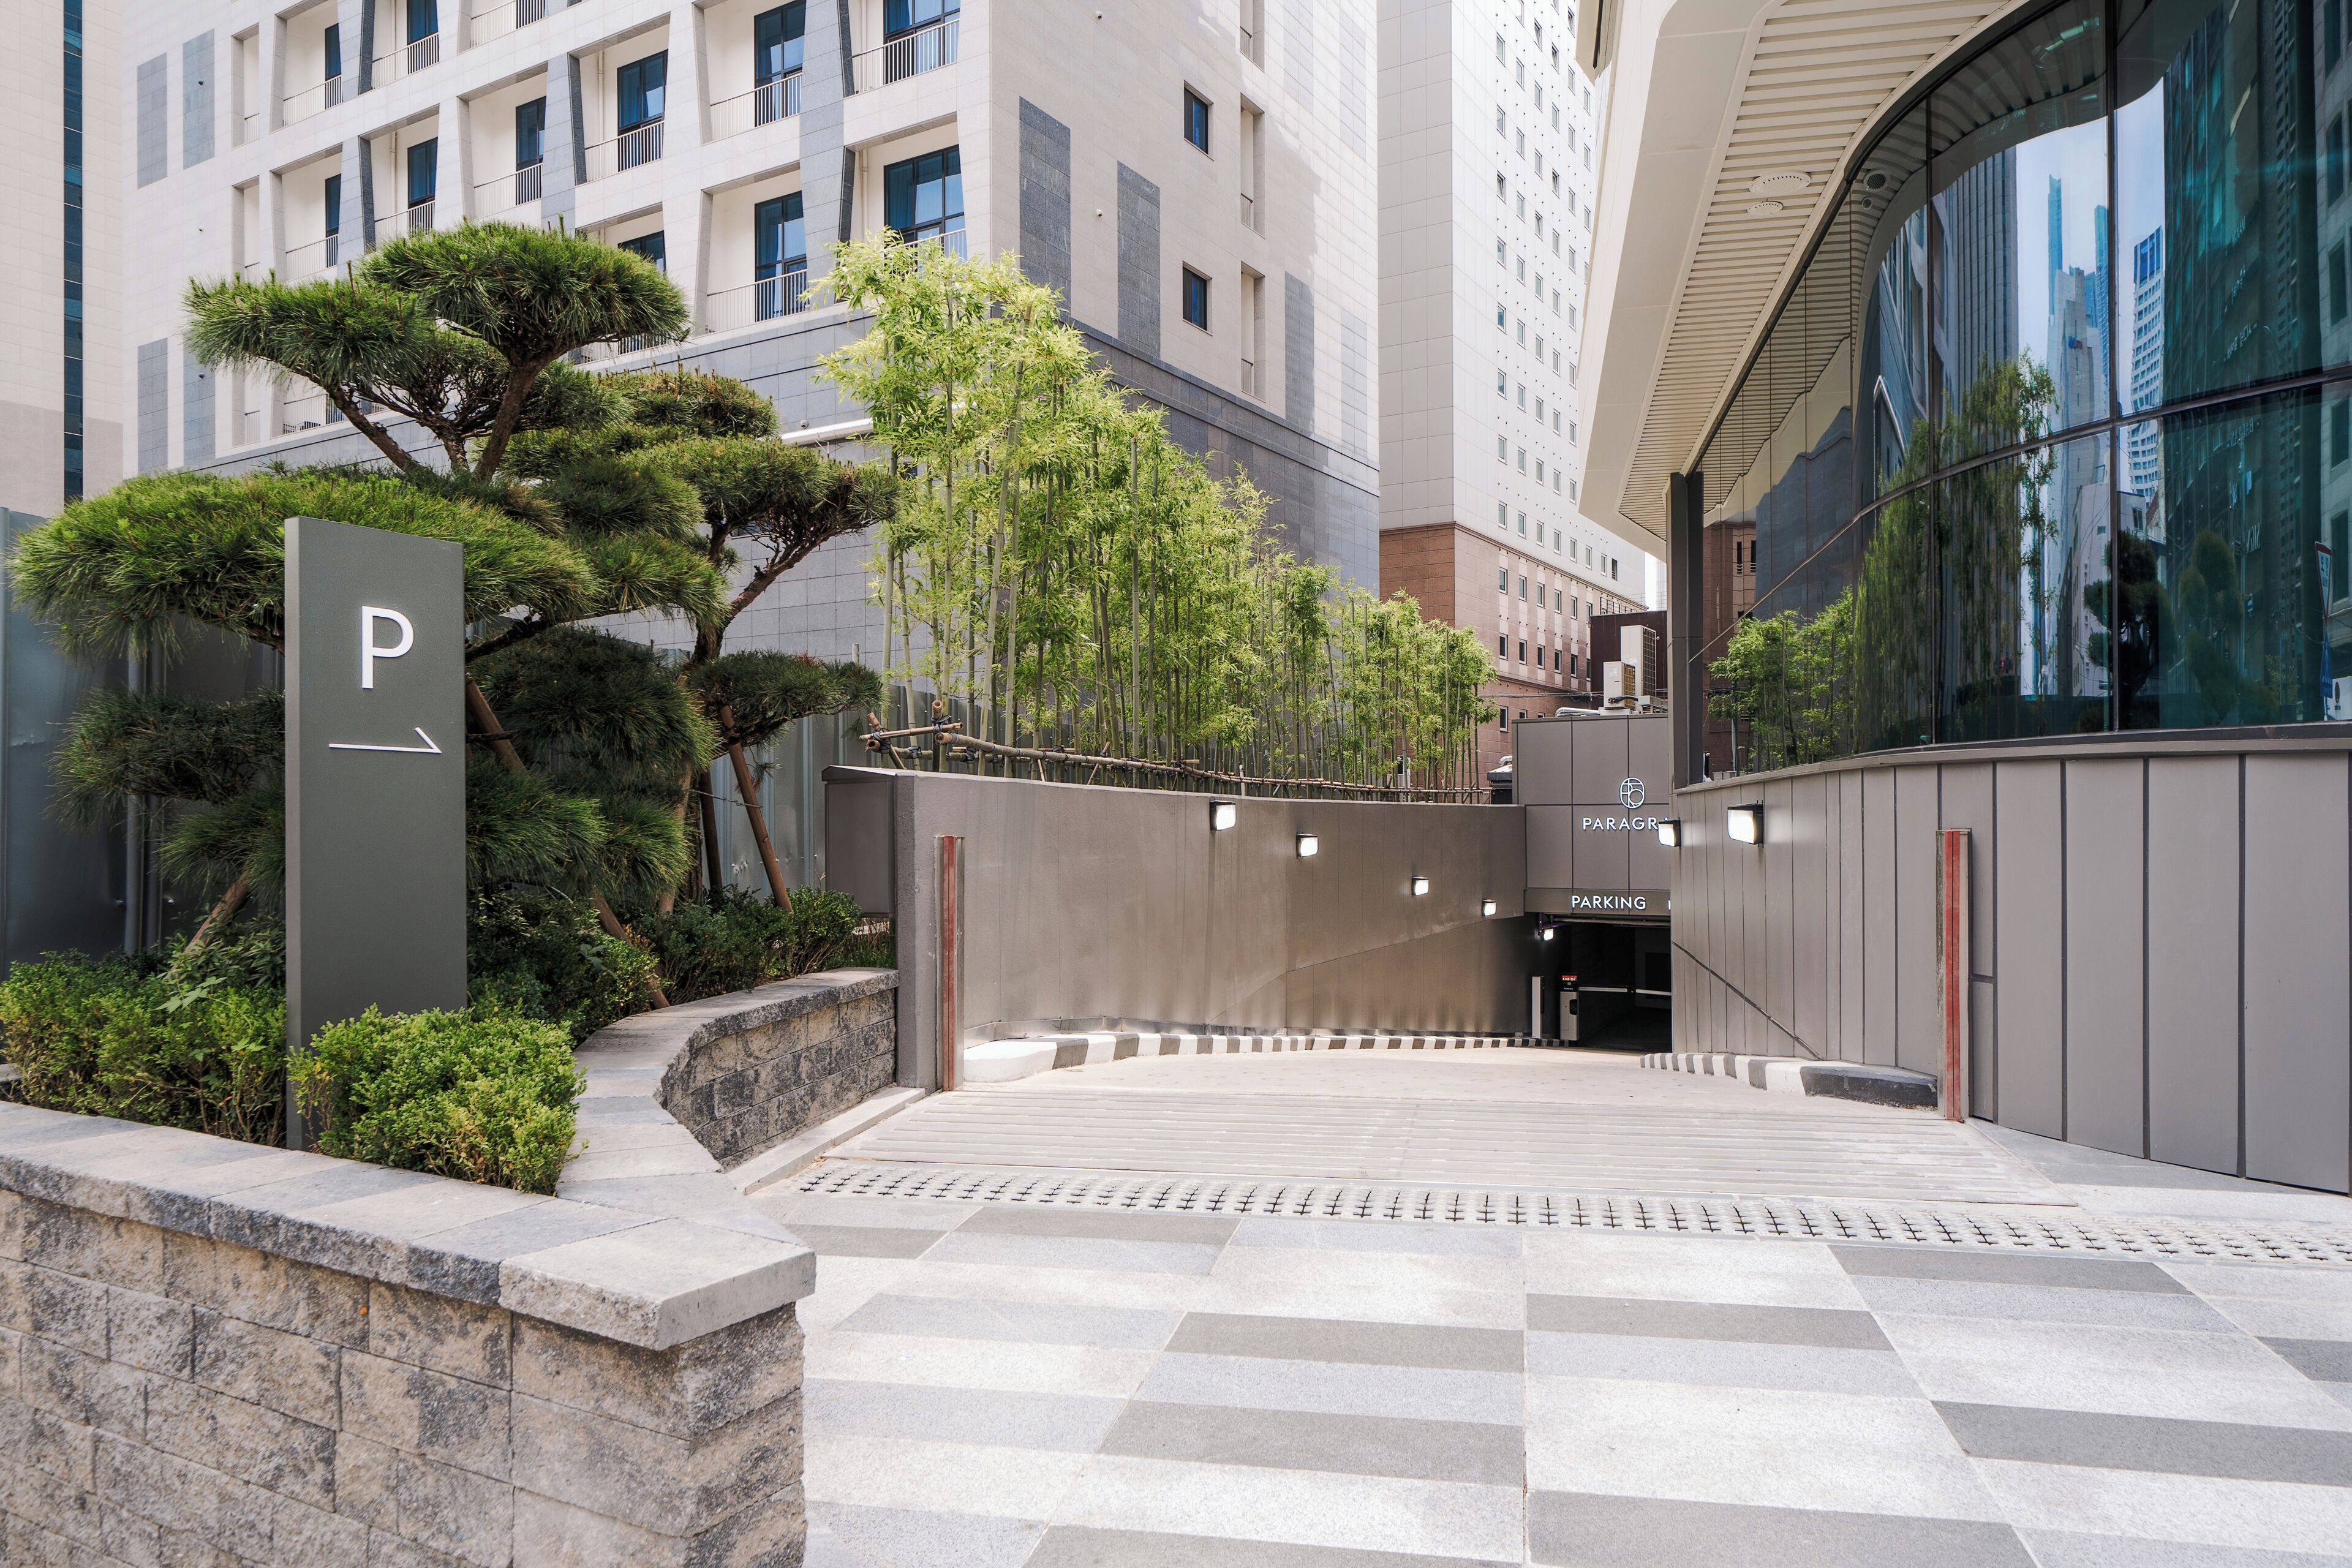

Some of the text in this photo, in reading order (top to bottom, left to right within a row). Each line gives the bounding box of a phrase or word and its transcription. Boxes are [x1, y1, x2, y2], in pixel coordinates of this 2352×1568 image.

[362, 606, 414, 689] P
[1583, 816, 1669, 831] PARAGR
[1572, 895, 1646, 910] PARKING
